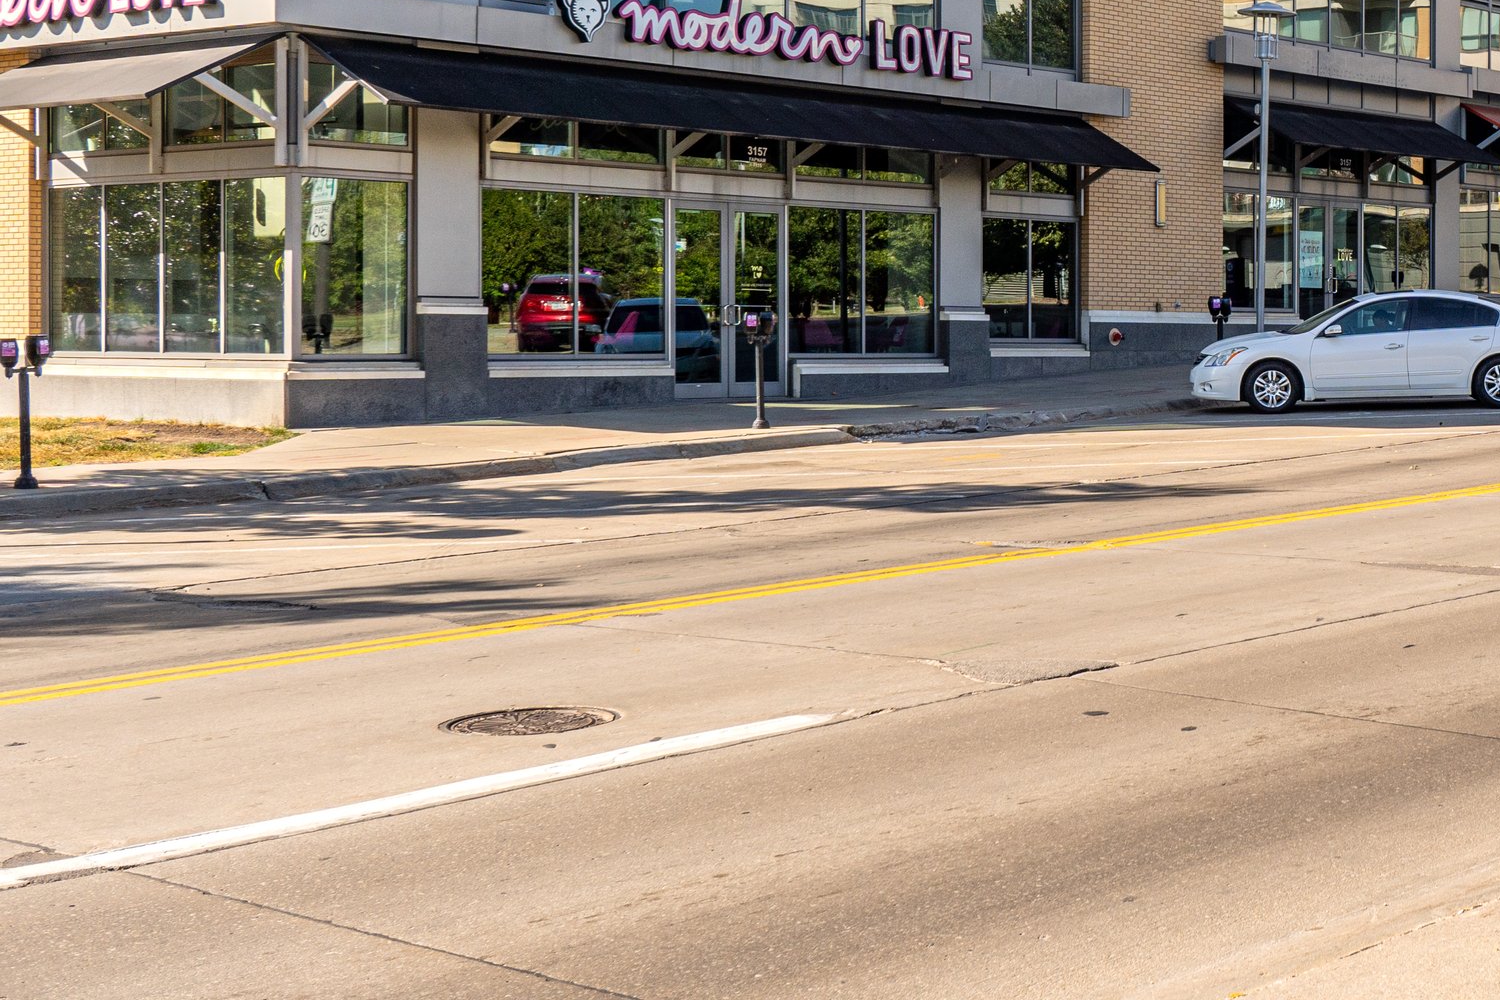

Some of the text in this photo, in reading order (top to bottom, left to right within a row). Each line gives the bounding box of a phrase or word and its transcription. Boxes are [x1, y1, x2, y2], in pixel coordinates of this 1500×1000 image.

[871, 18, 973, 81] LOVE
[747, 145, 768, 157] 3157
[1337, 252, 1353, 262] LOVE
